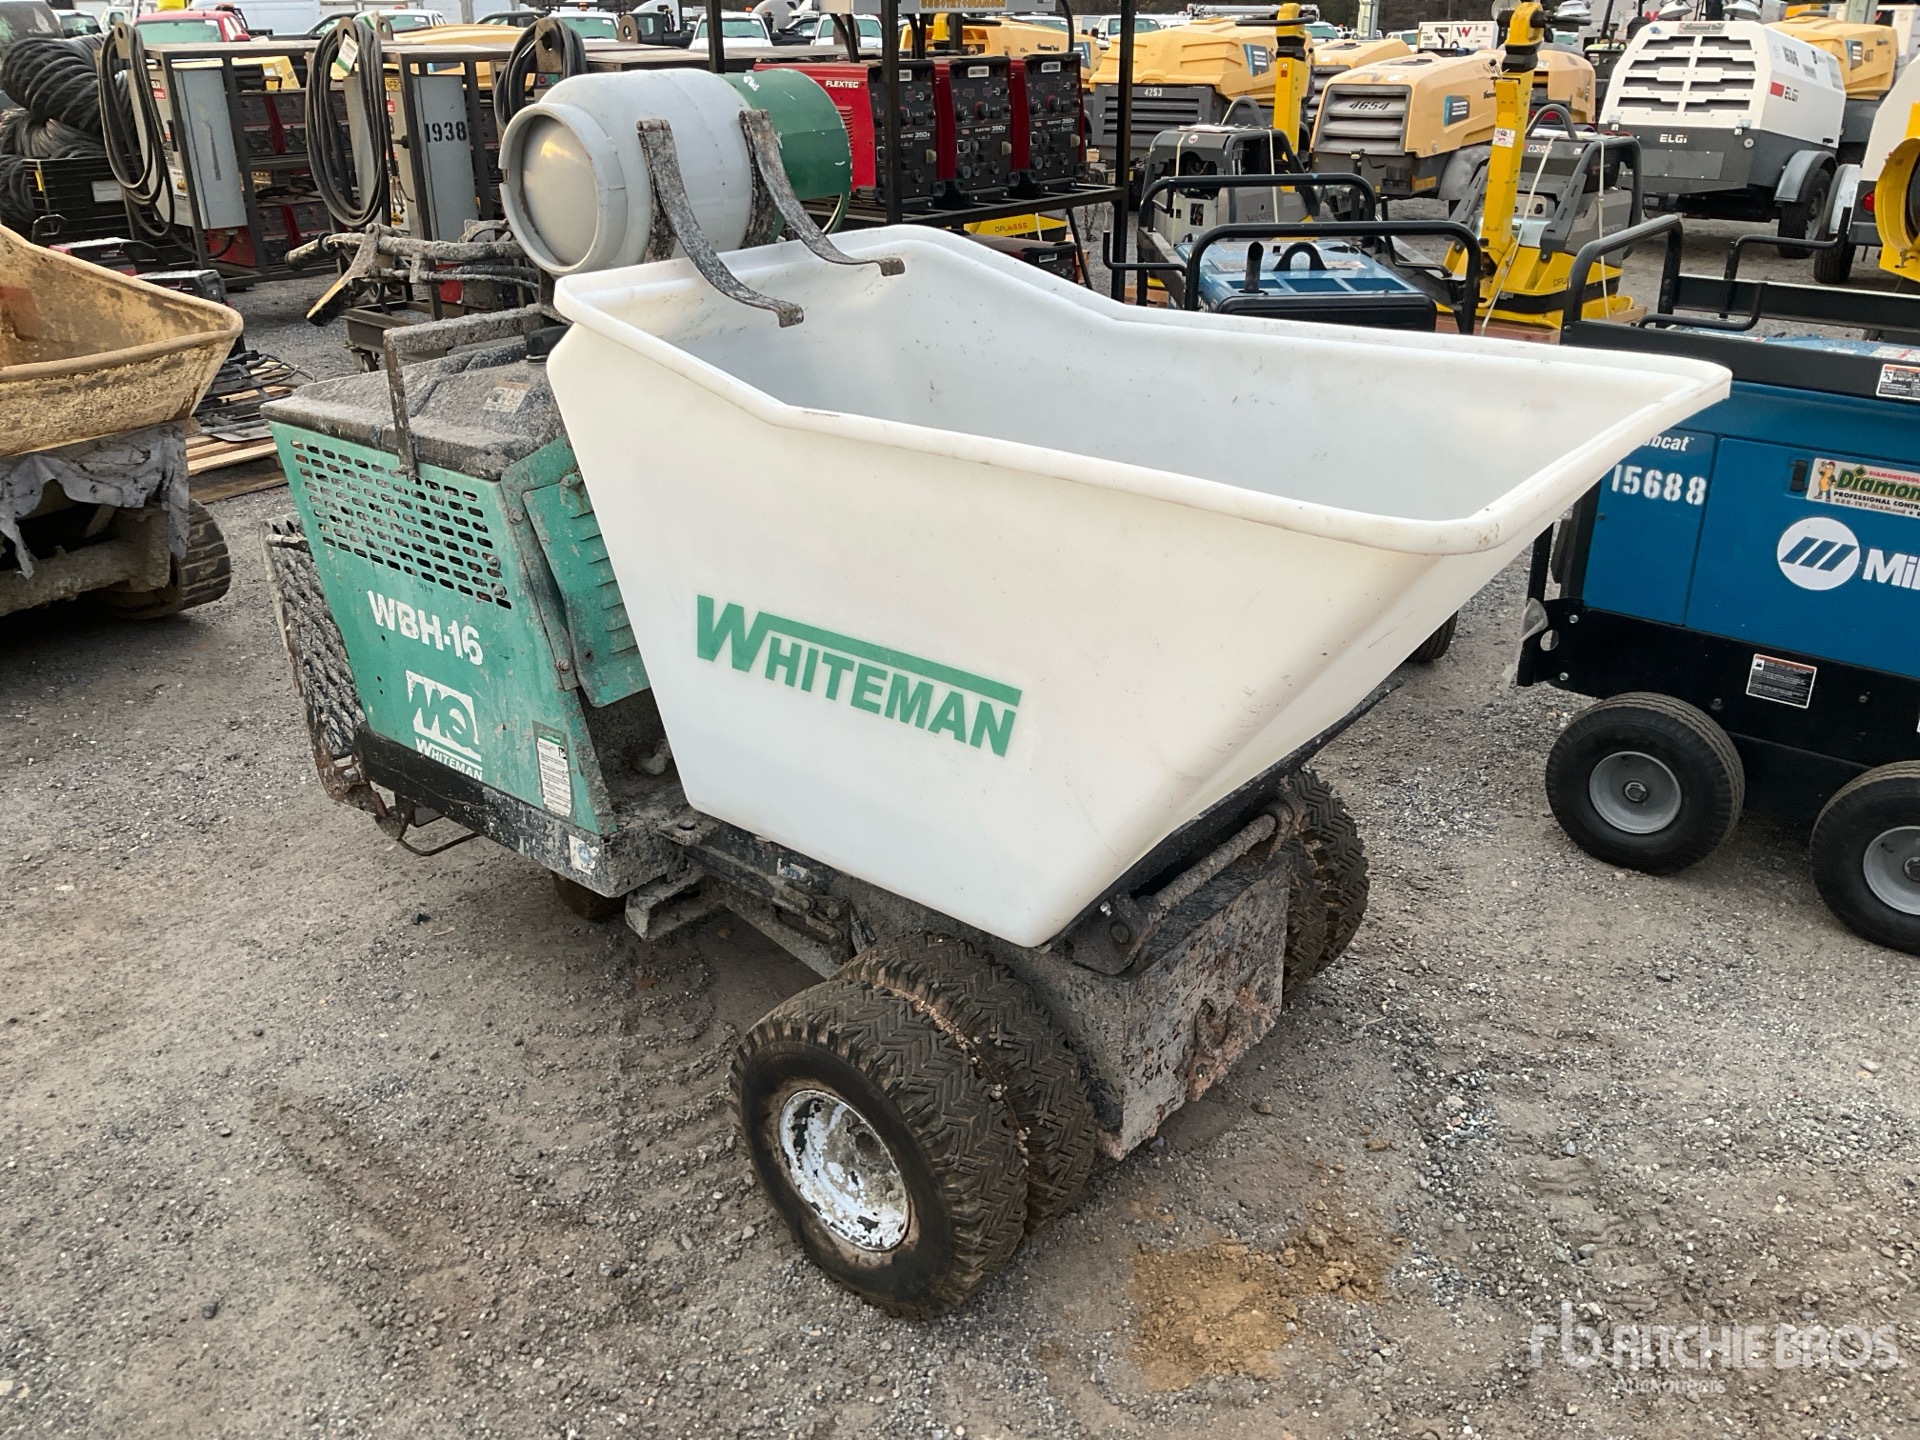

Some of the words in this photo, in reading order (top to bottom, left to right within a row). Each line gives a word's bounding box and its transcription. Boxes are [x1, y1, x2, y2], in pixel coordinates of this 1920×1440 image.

[825, 79, 859, 89] FLEXTEC
[1348, 100, 1392, 112] 4654
[425, 121, 468, 143] 1938
[1611, 464, 1707, 506] 15688
[1833, 490, 1891, 506] PROFESSIONAL
[1893, 500, 1920, 512] CONTR
[366, 589, 484, 667] WBH-16
[696, 593, 1023, 758] WHITEMAN
[414, 736, 484, 782] WHITEMAN
